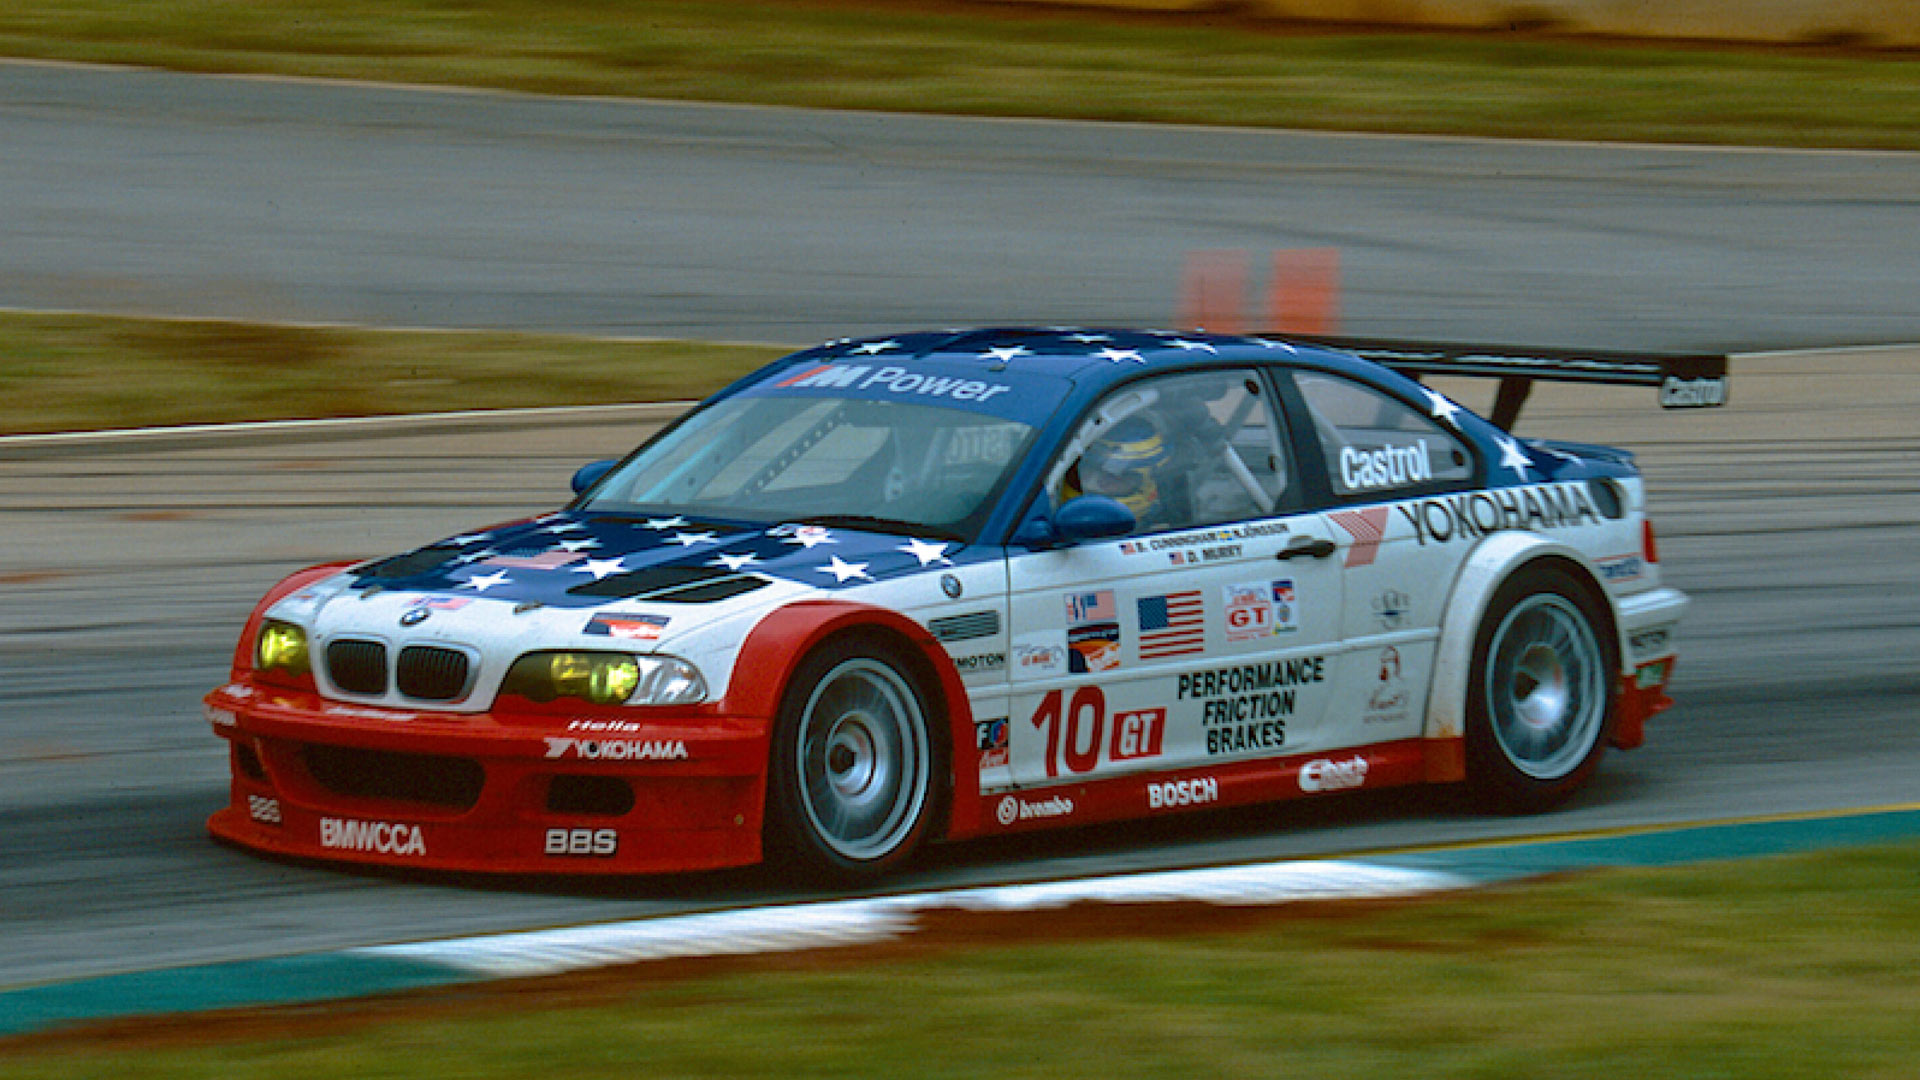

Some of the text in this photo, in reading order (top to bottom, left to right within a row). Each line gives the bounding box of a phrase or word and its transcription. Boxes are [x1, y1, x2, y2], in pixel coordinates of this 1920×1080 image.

[858, 366, 1011, 402] Power
[1339, 438, 1432, 489] Castrol
[1397, 483, 1602, 545] YOKOHAMA
[1229, 606, 1269, 628] GT
[1177, 655, 1325, 701] PERFORMANCE
[567, 719, 641, 732] Hella
[1203, 688, 1296, 726] FRICTION
[1030, 684, 1106, 778] 10
[1117, 712, 1158, 757] GT
[1207, 718, 1286, 755] BRAKES
[574, 739, 689, 761] YOKOHAMA
[1147, 776, 1219, 809] BOSCH
[318, 815, 428, 857] BMWCCA
[544, 828, 618, 855] BBS
